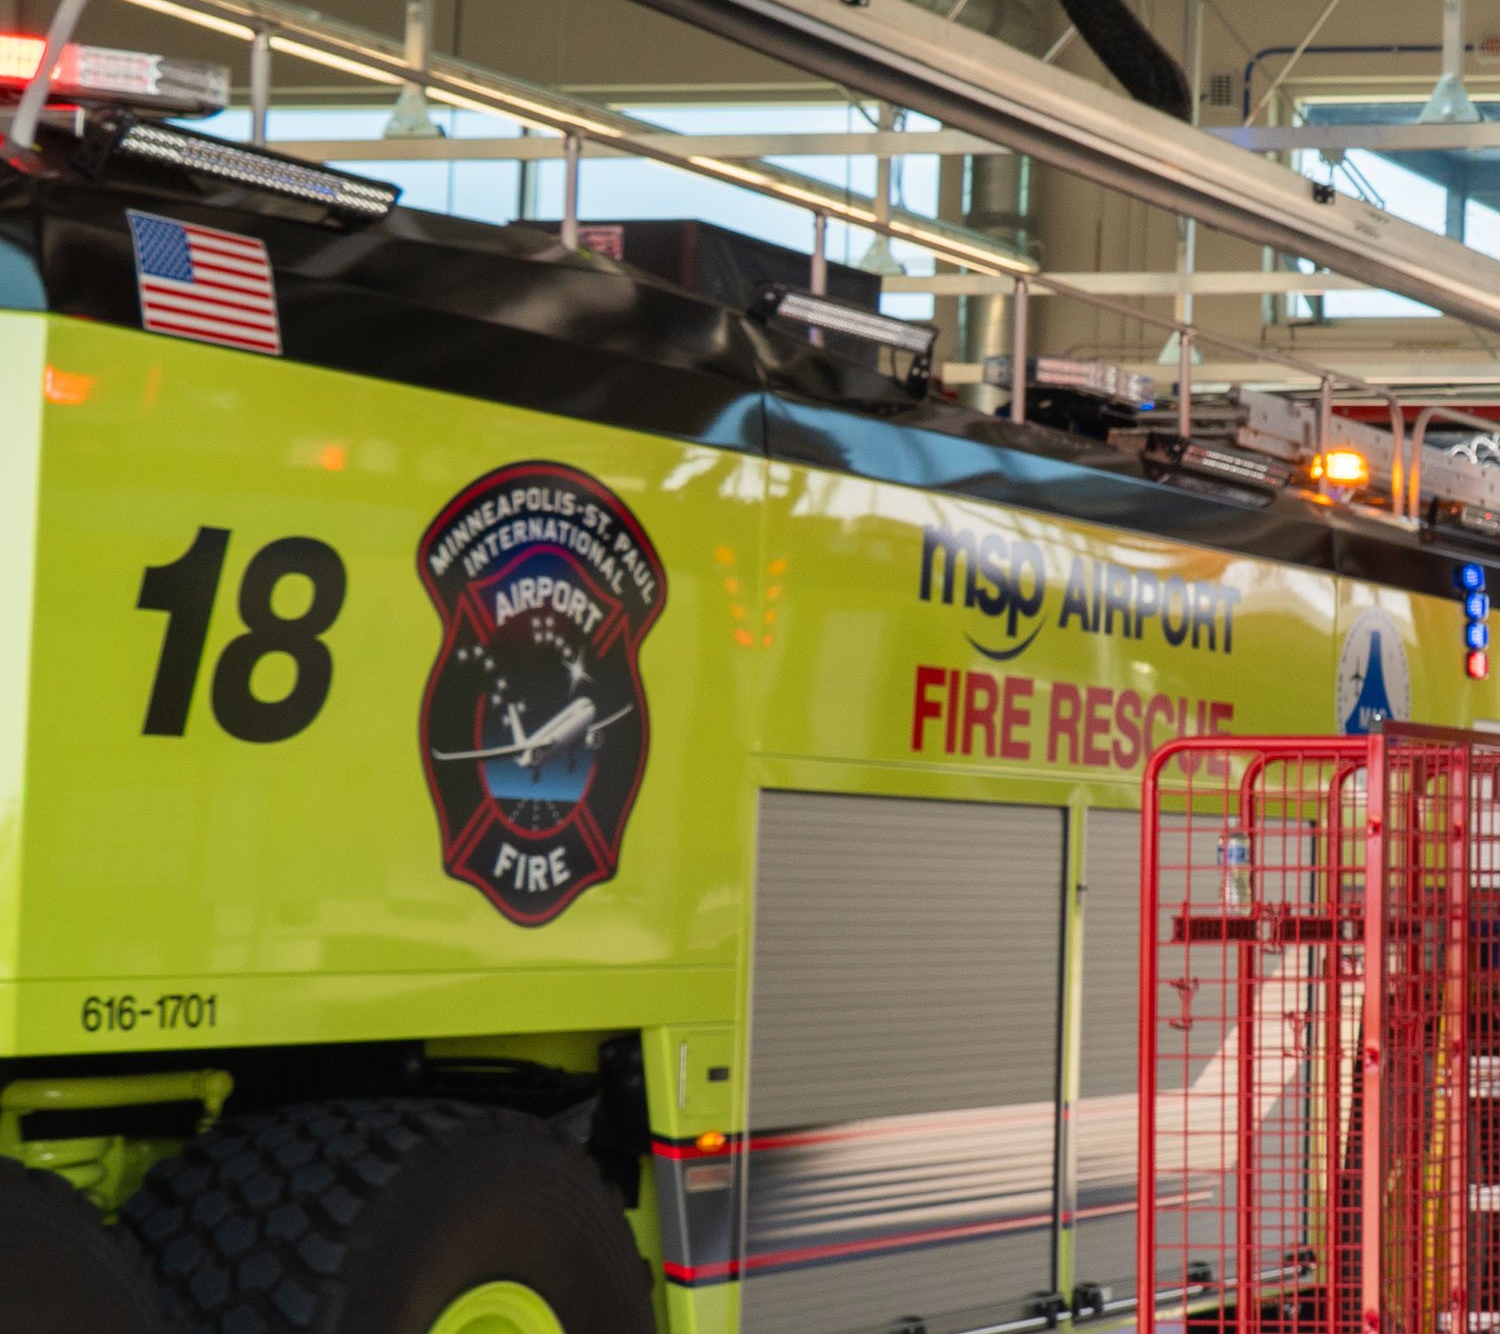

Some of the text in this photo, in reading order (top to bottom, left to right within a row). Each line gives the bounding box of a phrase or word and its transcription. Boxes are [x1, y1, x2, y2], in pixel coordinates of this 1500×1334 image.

[462, 516, 626, 595] INTERNATIONAL
[614, 535, 656, 604] PAUL
[919, 524, 1242, 654] msp AIRPORT
[135, 525, 348, 744] 18
[495, 575, 605, 635] AIRPORT
[912, 664, 1235, 778] FIRE RESCUE
[493, 842, 572, 893] FIRE
[81, 993, 217, 1032] 616-1701
